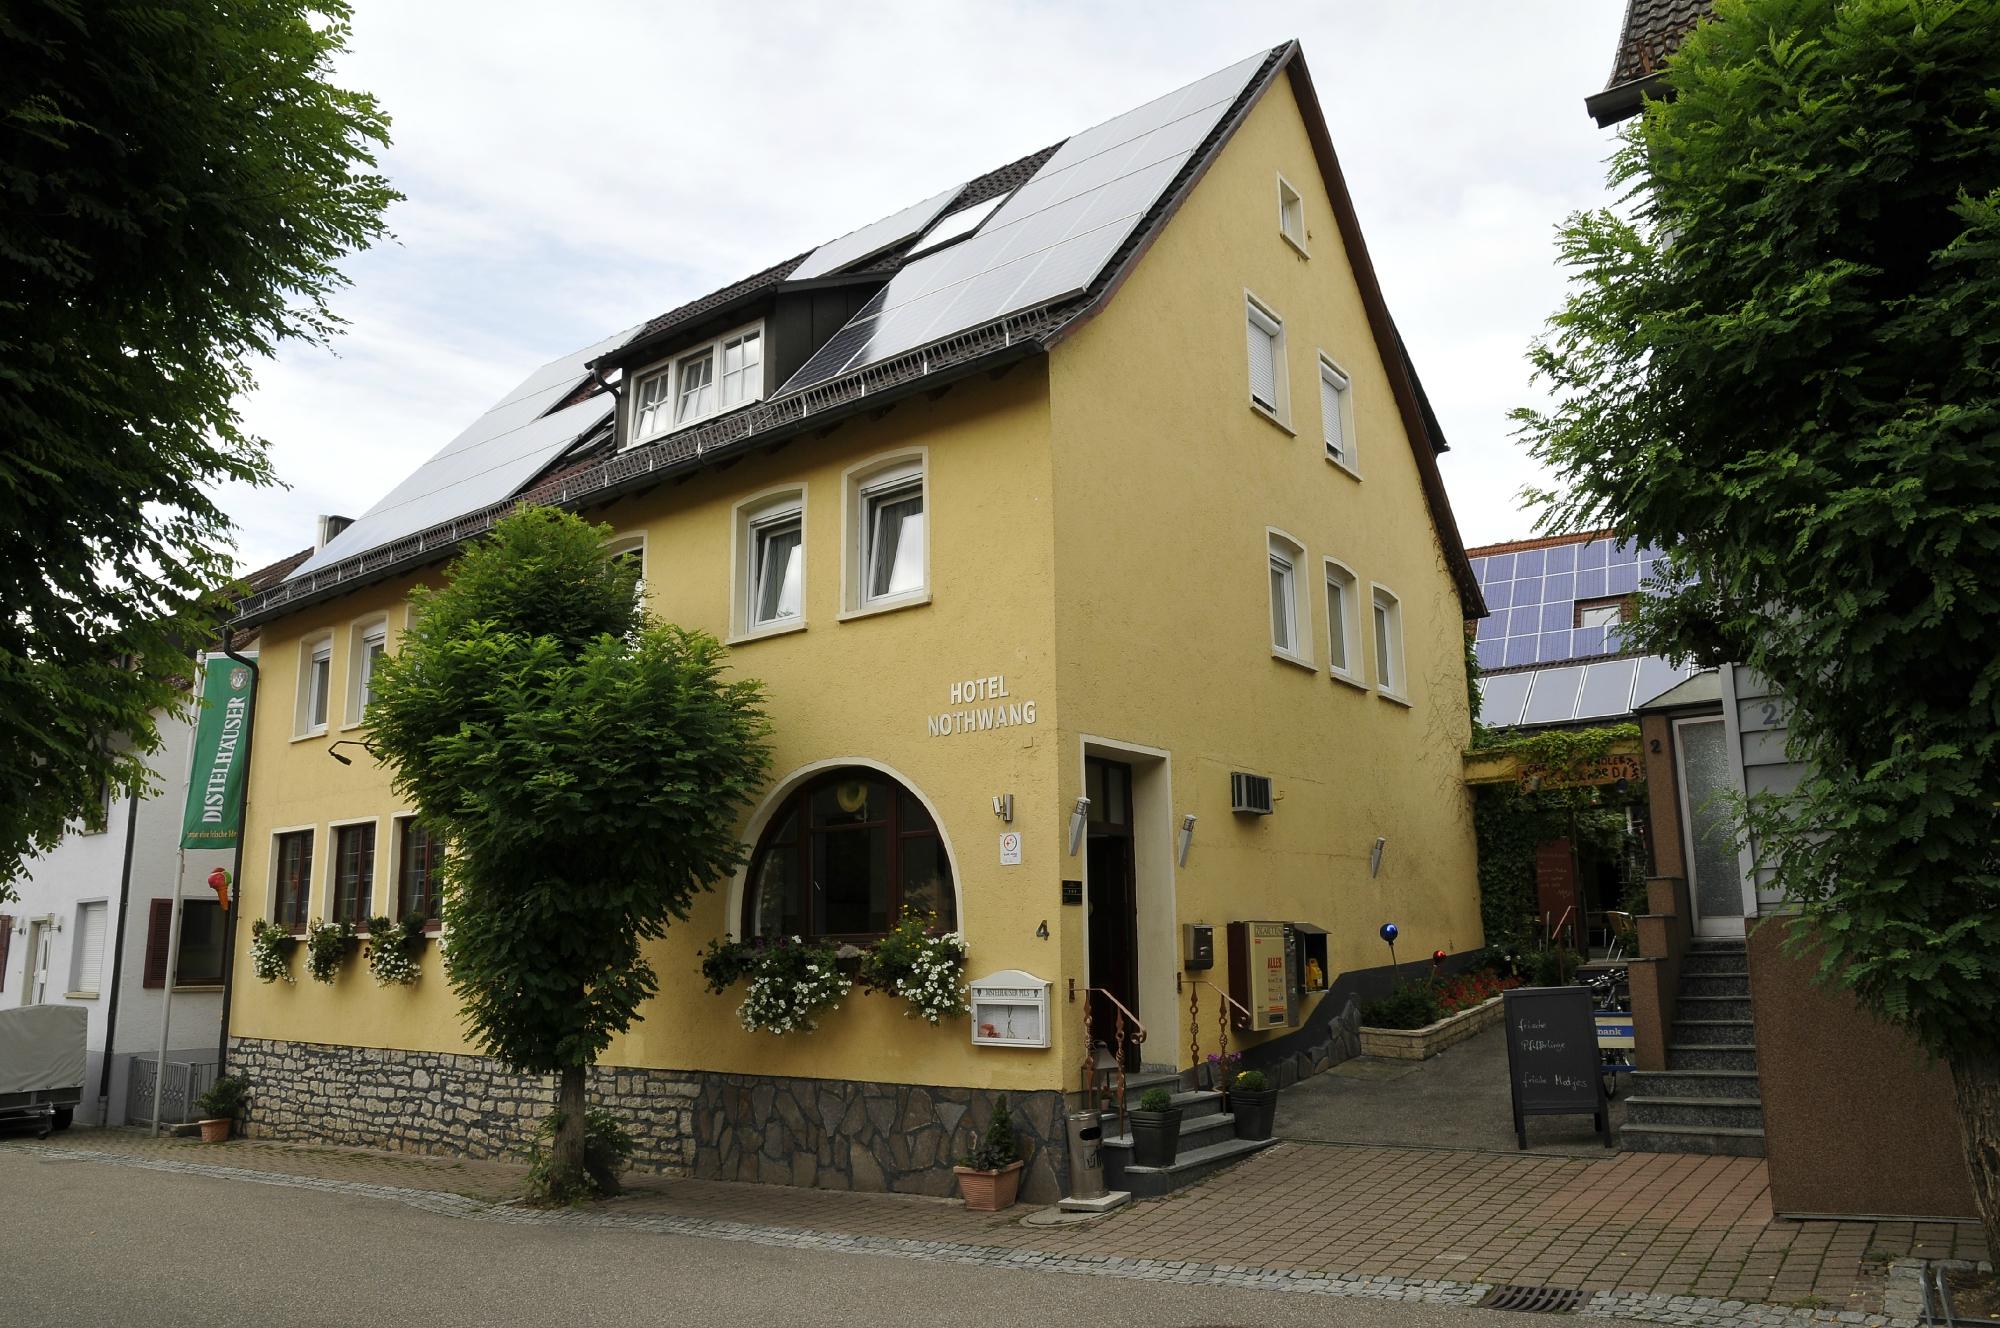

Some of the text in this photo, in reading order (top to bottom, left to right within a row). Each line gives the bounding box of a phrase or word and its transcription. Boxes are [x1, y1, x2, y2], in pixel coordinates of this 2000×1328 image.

[950, 675, 1010, 705] HOTEL
[927, 701, 1037, 737] NOTHWANG
[1761, 703, 1778, 725] 2
[1650, 739, 1661, 753] 2
[202, 696, 247, 823] DISTELHÄUSER
[1036, 919, 1050, 941] 4
[1267, 957, 1282, 969] ALLES
